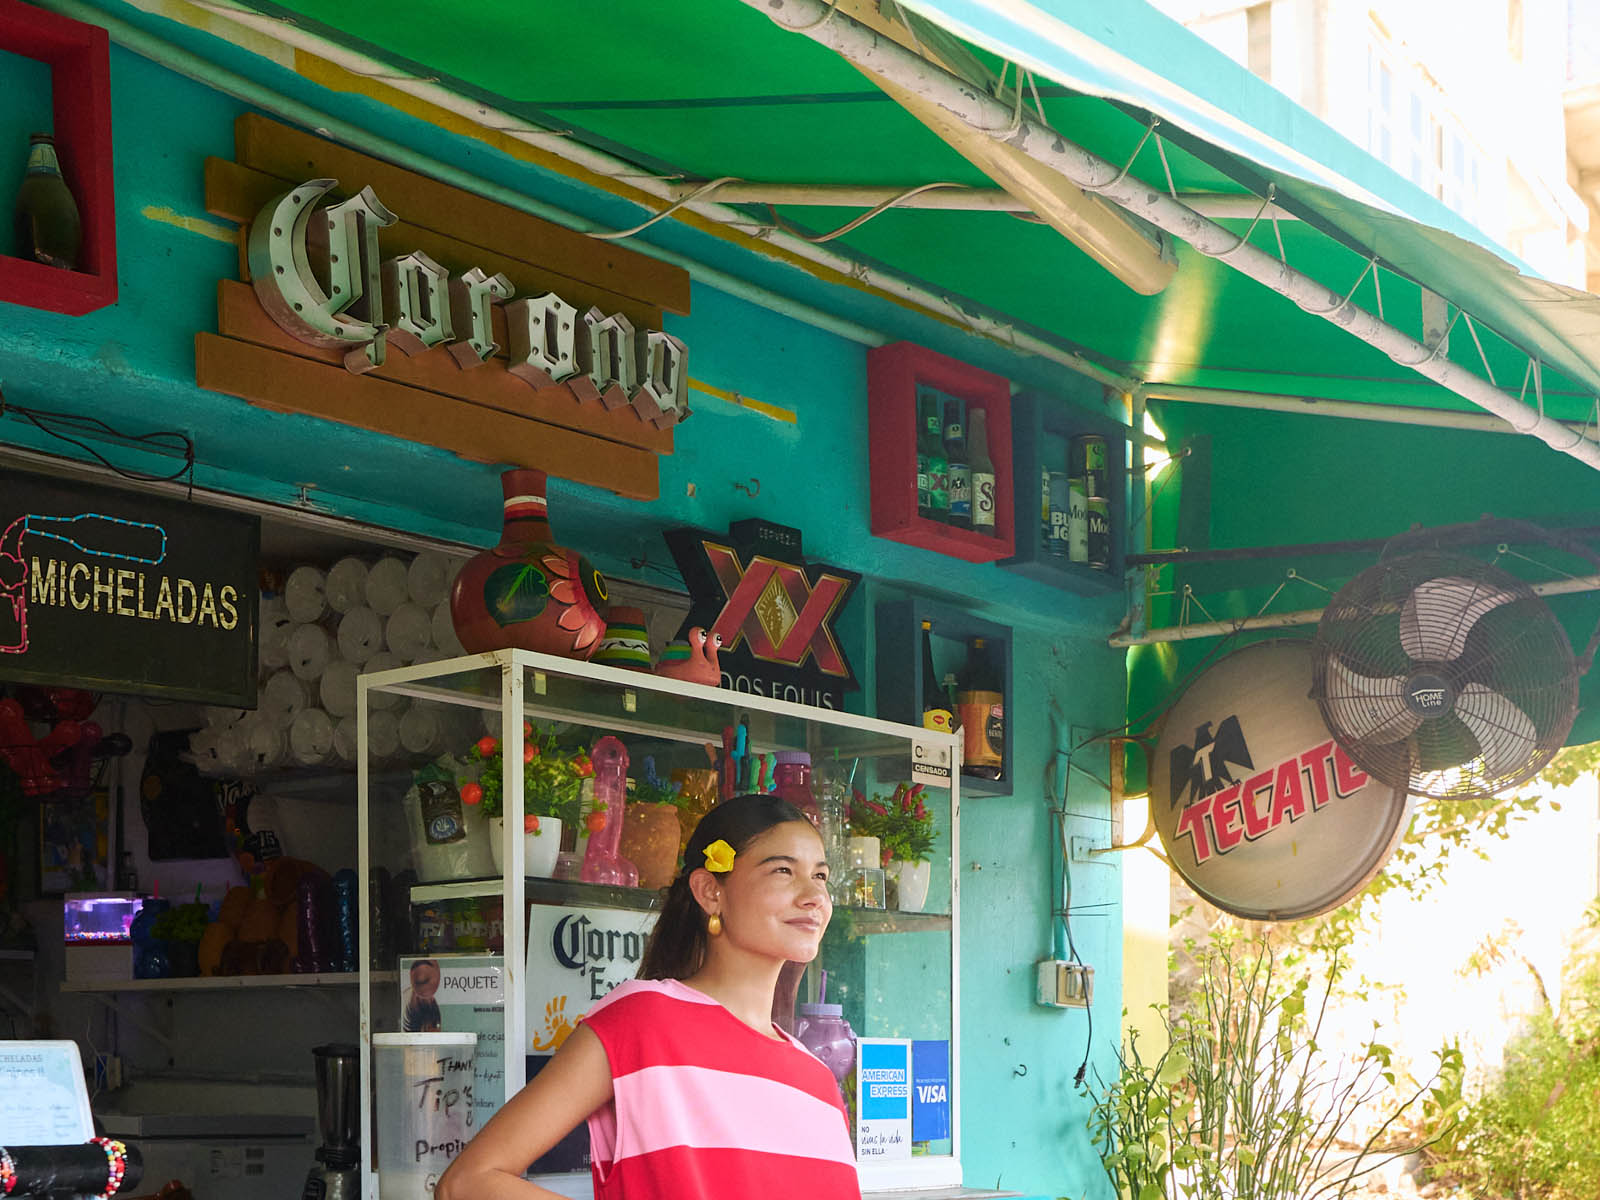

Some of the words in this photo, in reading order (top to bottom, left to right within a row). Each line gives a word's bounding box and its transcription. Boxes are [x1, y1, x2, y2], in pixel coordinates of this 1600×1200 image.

[250, 178, 693, 431] Corona
[31, 556, 239, 631] MICHELADAS
[1415, 690, 1443, 703] HOME
[914, 763, 948, 777] CENSADO
[1174, 737, 1374, 867] TECATE
[443, 975, 499, 990] PAQUETE
[862, 1070, 905, 1081] AMERICAN
[872, 1085, 908, 1096] EXPRESS
[916, 1085, 947, 1104] VISA
[861, 1147, 871, 1155] SIN
[872, 1147, 885, 1155] ELLA
